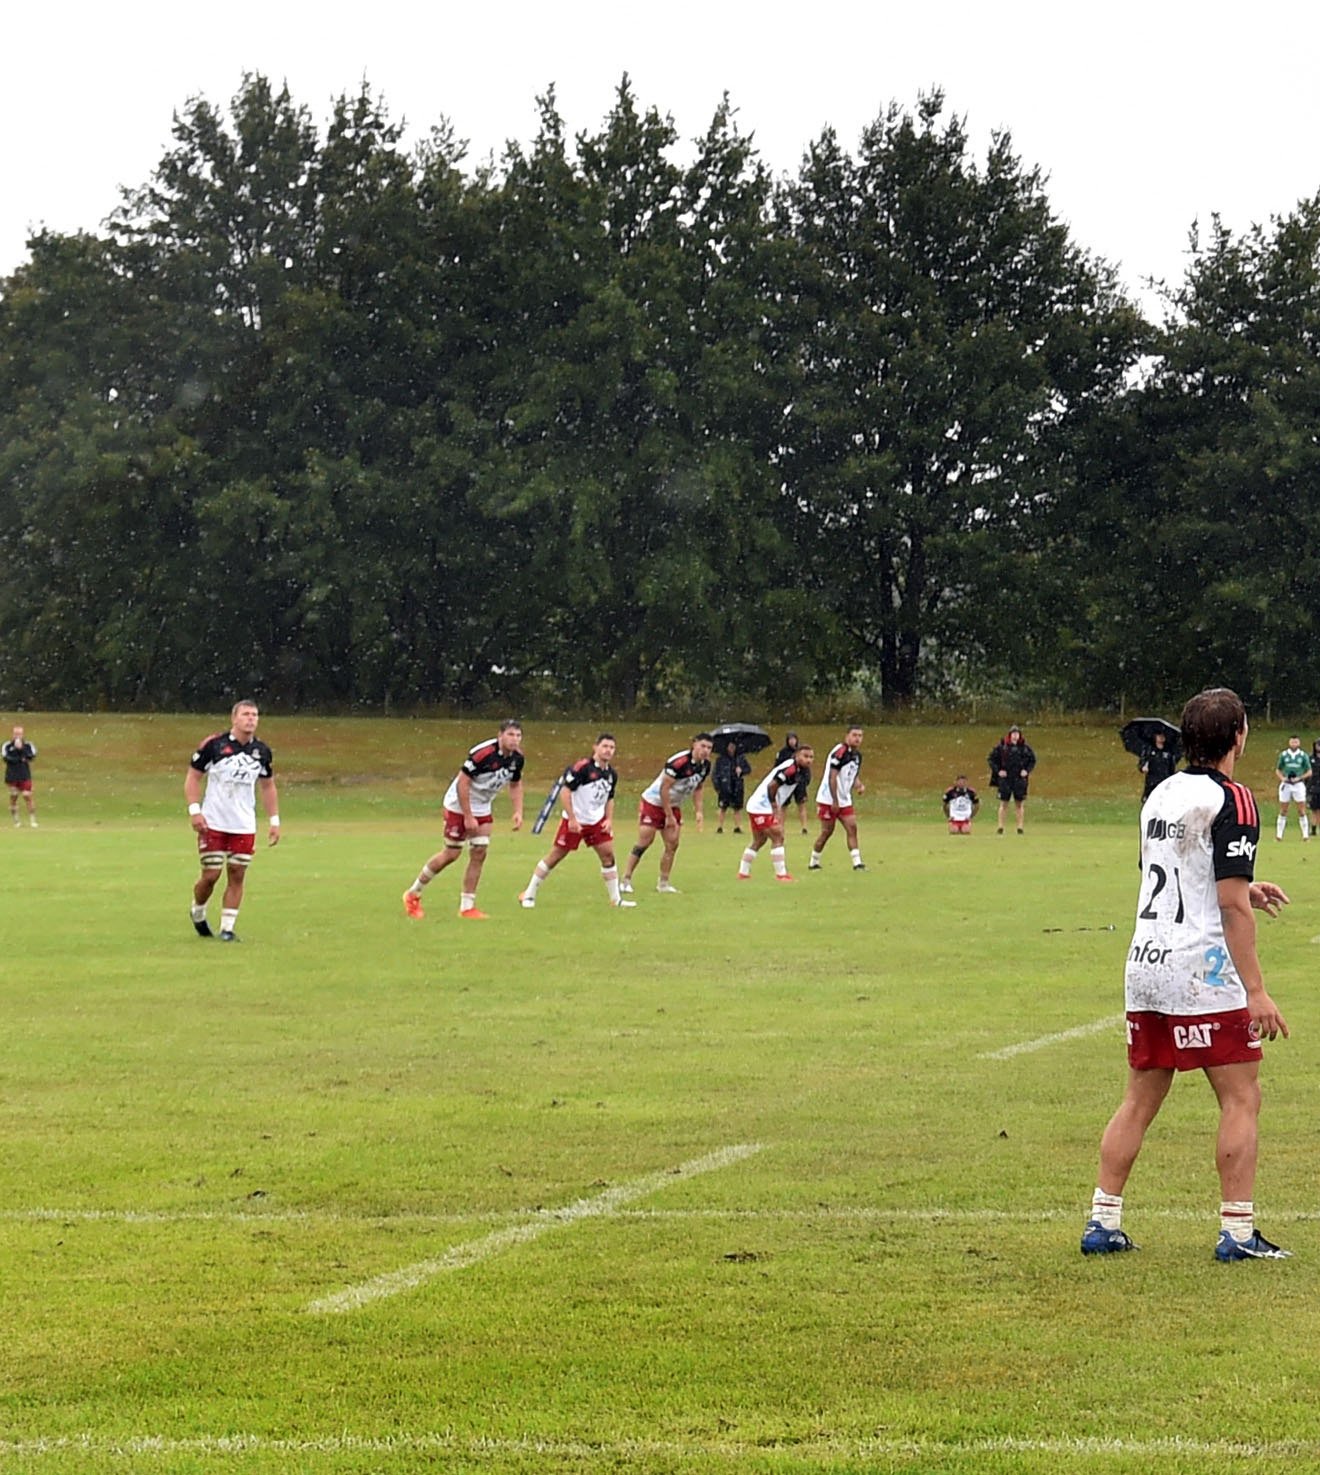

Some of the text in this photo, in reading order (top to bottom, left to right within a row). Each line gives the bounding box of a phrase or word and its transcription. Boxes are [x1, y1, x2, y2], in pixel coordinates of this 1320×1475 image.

[1226, 835, 1256, 862] sky
[1139, 863, 1185, 925] 21
[1129, 940, 1173, 965] nfor
[1173, 1022, 1213, 1050] CAT
